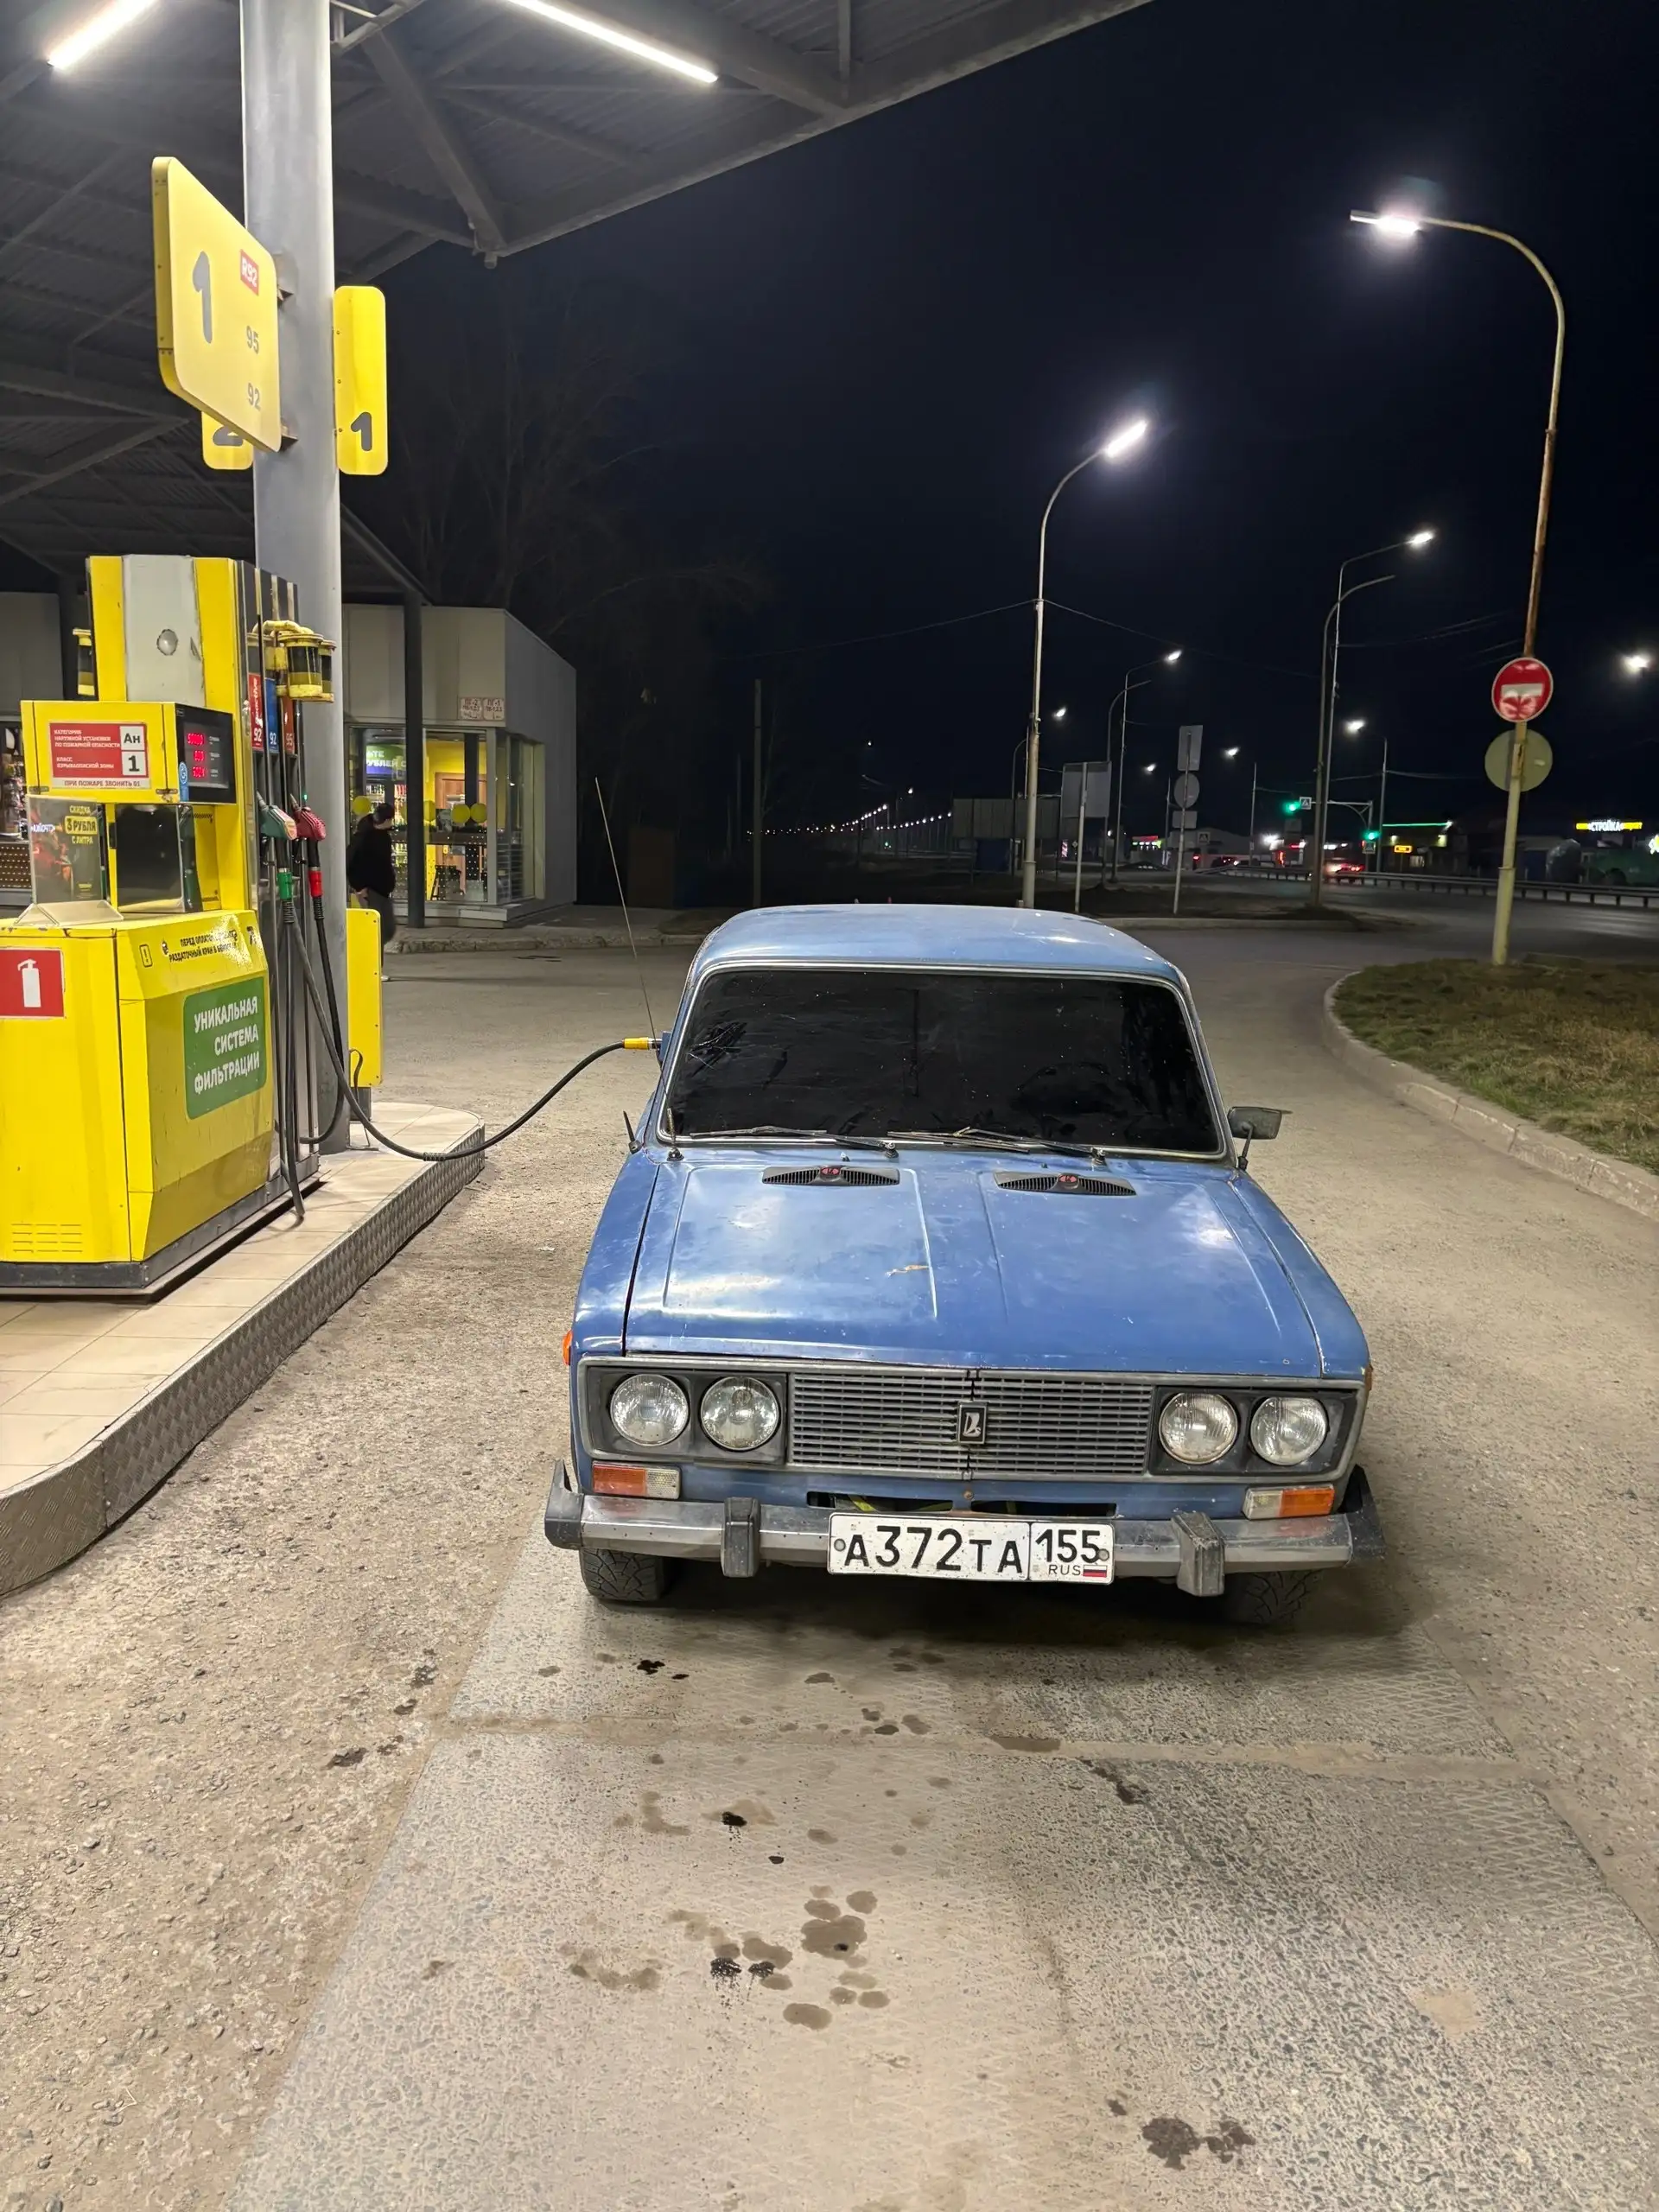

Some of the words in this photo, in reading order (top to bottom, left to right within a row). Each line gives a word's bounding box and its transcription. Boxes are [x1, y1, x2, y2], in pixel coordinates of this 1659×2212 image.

[193, 251, 213, 344] 1
[246, 325, 259, 355] 95
[247, 383, 261, 412] 92
[350, 411, 372, 452] 1
[124, 733, 141, 744] Ан
[253, 728, 263, 742] 92
[270, 732, 276, 745] 92
[128, 755, 140, 772] 1
[69, 805, 91, 815] СКИДКА
[67, 817, 73, 831] 3
[73, 820, 96, 831] РУБЛЯ
[76, 836, 93, 845] ЛИТРА
[195, 933, 214, 945] ОПЛАТО
[194, 995, 258, 1033] УНИКАЛЬНАЯ
[214, 1024, 259, 1056] СИСТЕМА
[194, 1051, 260, 1095] ФИЛЬТРАЦИИ
[844, 1526, 1023, 1573] А372ТА
[1035, 1529, 1101, 1563] 155
[1048, 1564, 1082, 1576] RUS
